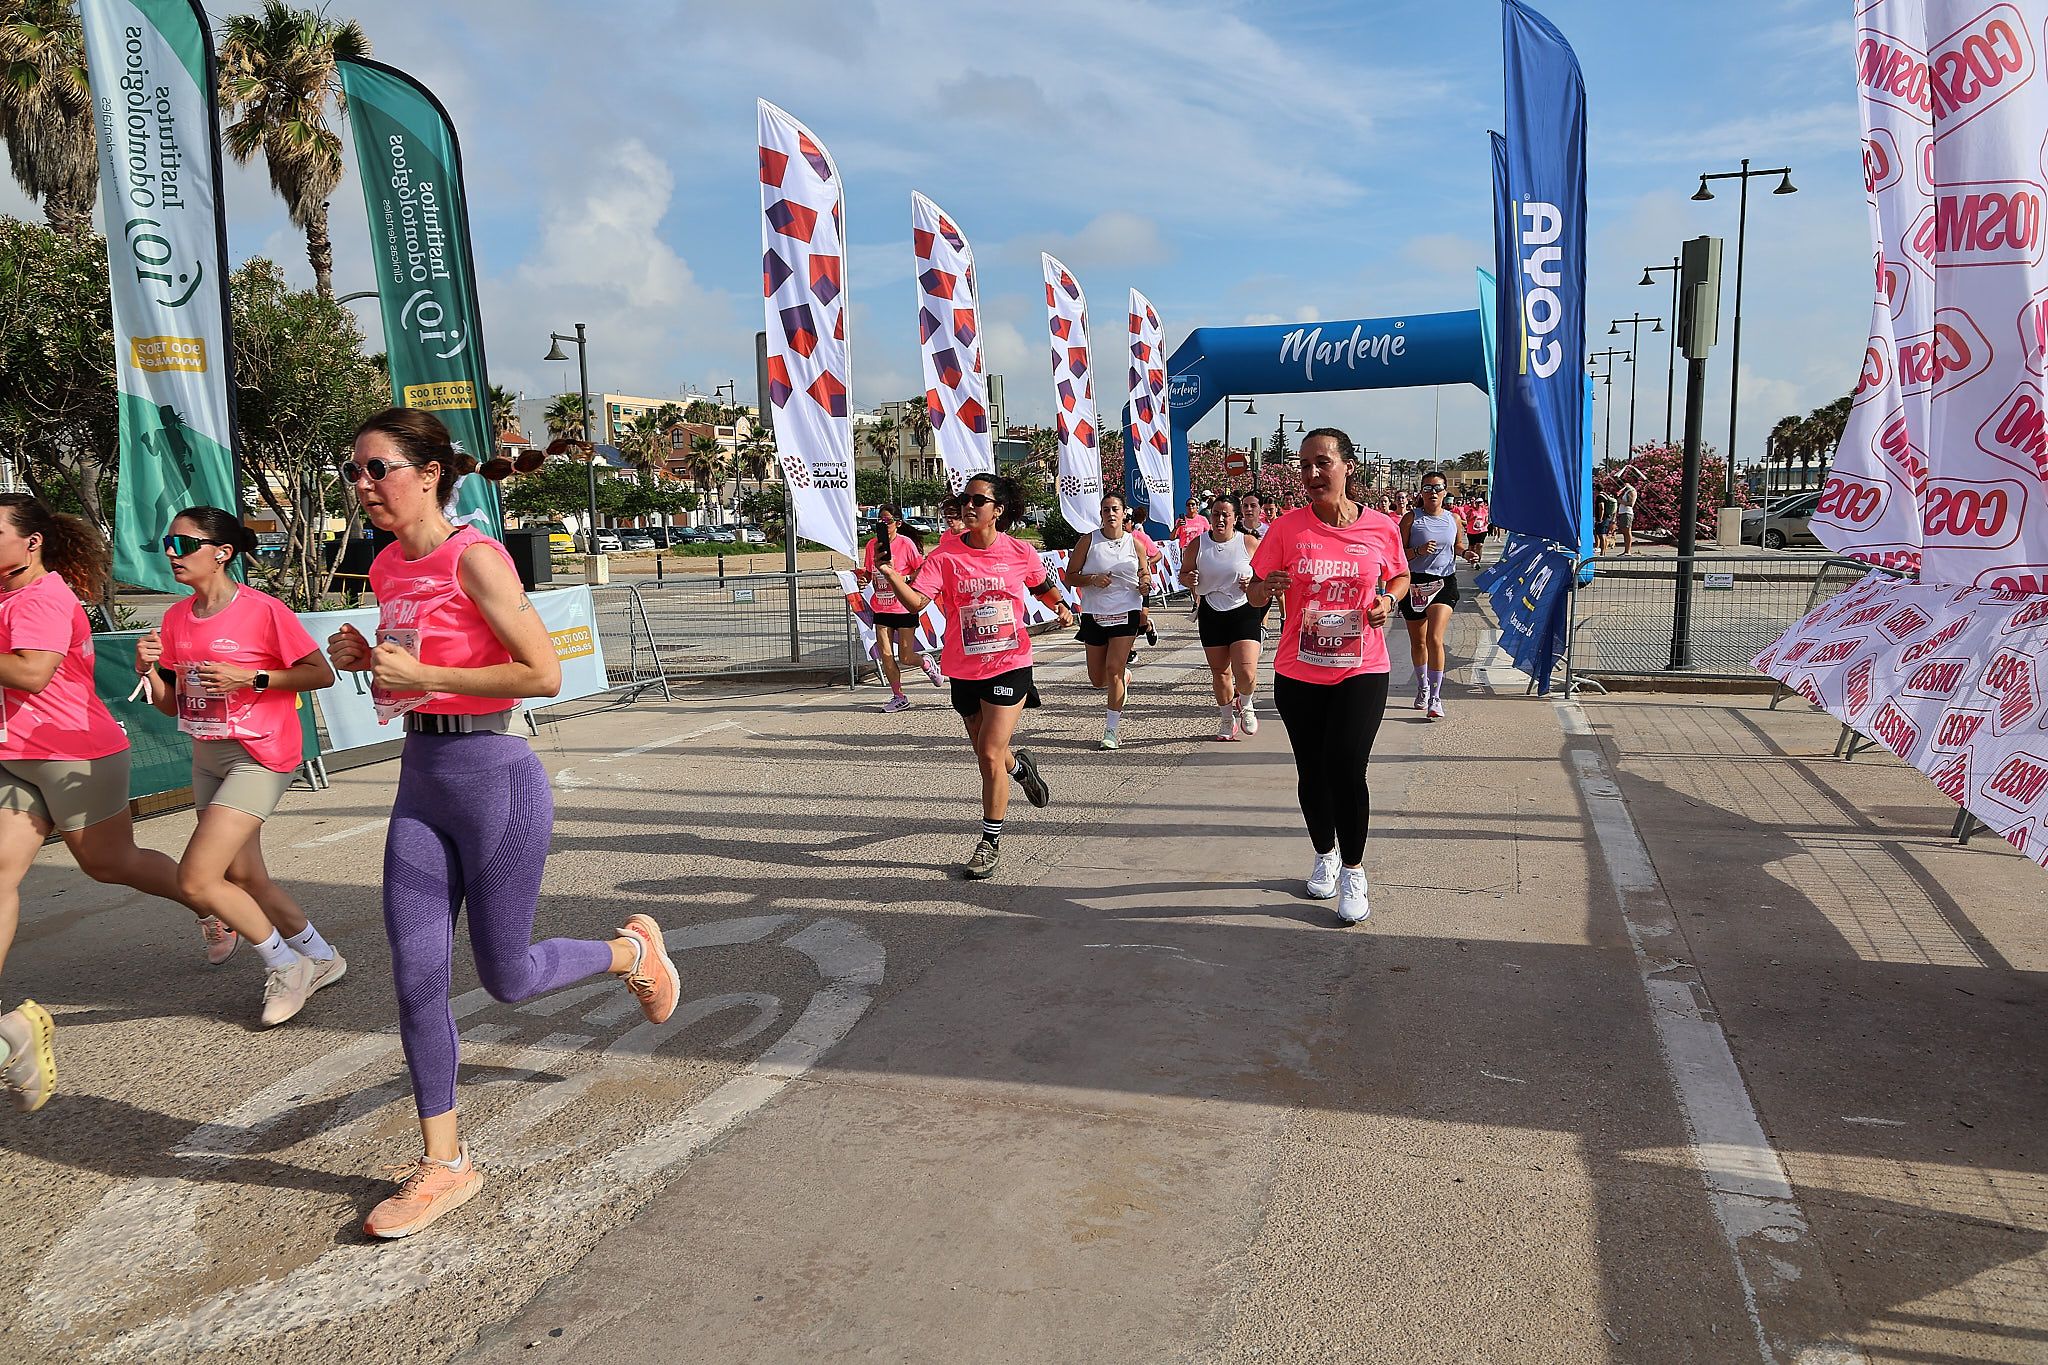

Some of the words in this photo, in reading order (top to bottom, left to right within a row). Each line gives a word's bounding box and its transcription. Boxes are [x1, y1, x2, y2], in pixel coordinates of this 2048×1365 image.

[1279, 324, 1406, 382] Marlene
[1296, 542, 1323, 550] OYSHO
[1297, 558, 1360, 577] CARRERA
[957, 576, 1006, 594] CARRERA
[572, 630, 590, 642] 002
[978, 625, 999, 635] 016
[1317, 636, 1343, 646] 016
[1902, 616, 1969, 664] COSMO
[1304, 654, 1323, 663] OYSHO
[1808, 639, 1862, 664] COSMO
[1908, 662, 1964, 694] COSMO
[1874, 702, 1916, 759] COSMO
